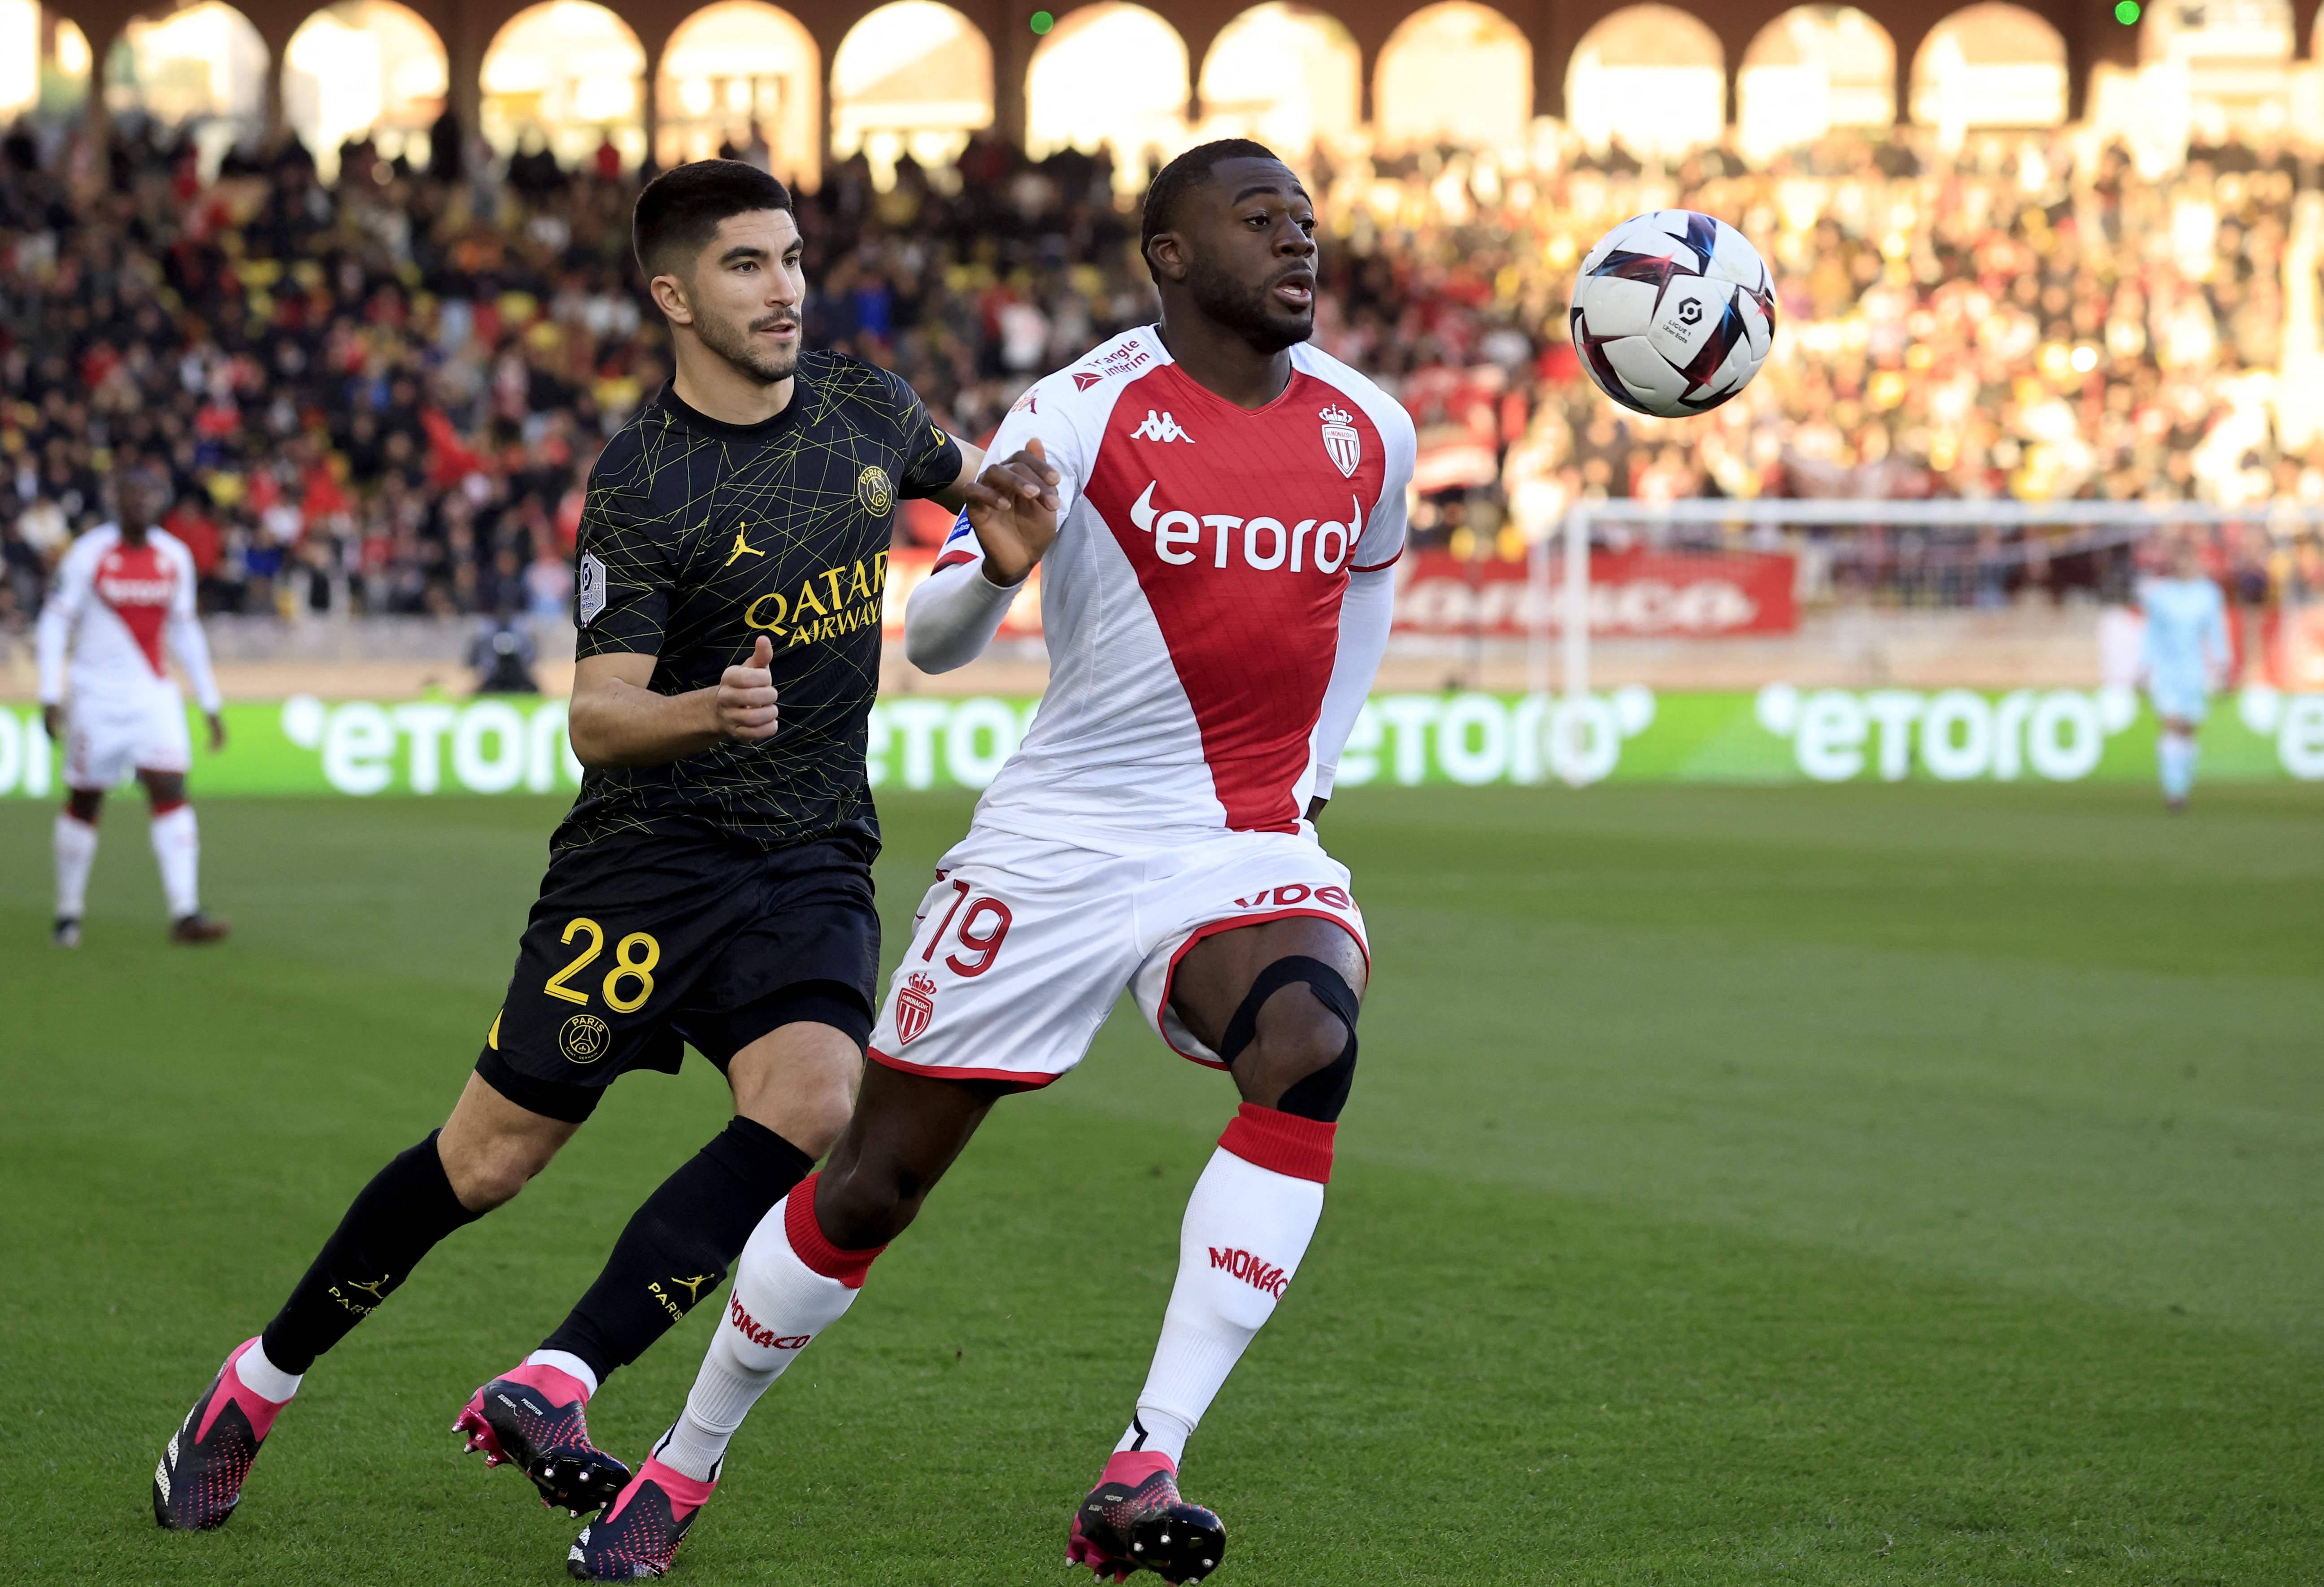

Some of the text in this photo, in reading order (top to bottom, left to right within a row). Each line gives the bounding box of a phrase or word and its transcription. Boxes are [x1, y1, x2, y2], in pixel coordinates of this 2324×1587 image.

[861, 469, 882, 484] PARIS
[744, 550, 889, 637] QATAR
[544, 917, 660, 1013] 28
[906, 996, 924, 1009] MONACO
[572, 1017, 605, 1032] PARIS
[648, 1282, 683, 1322] PARIS
